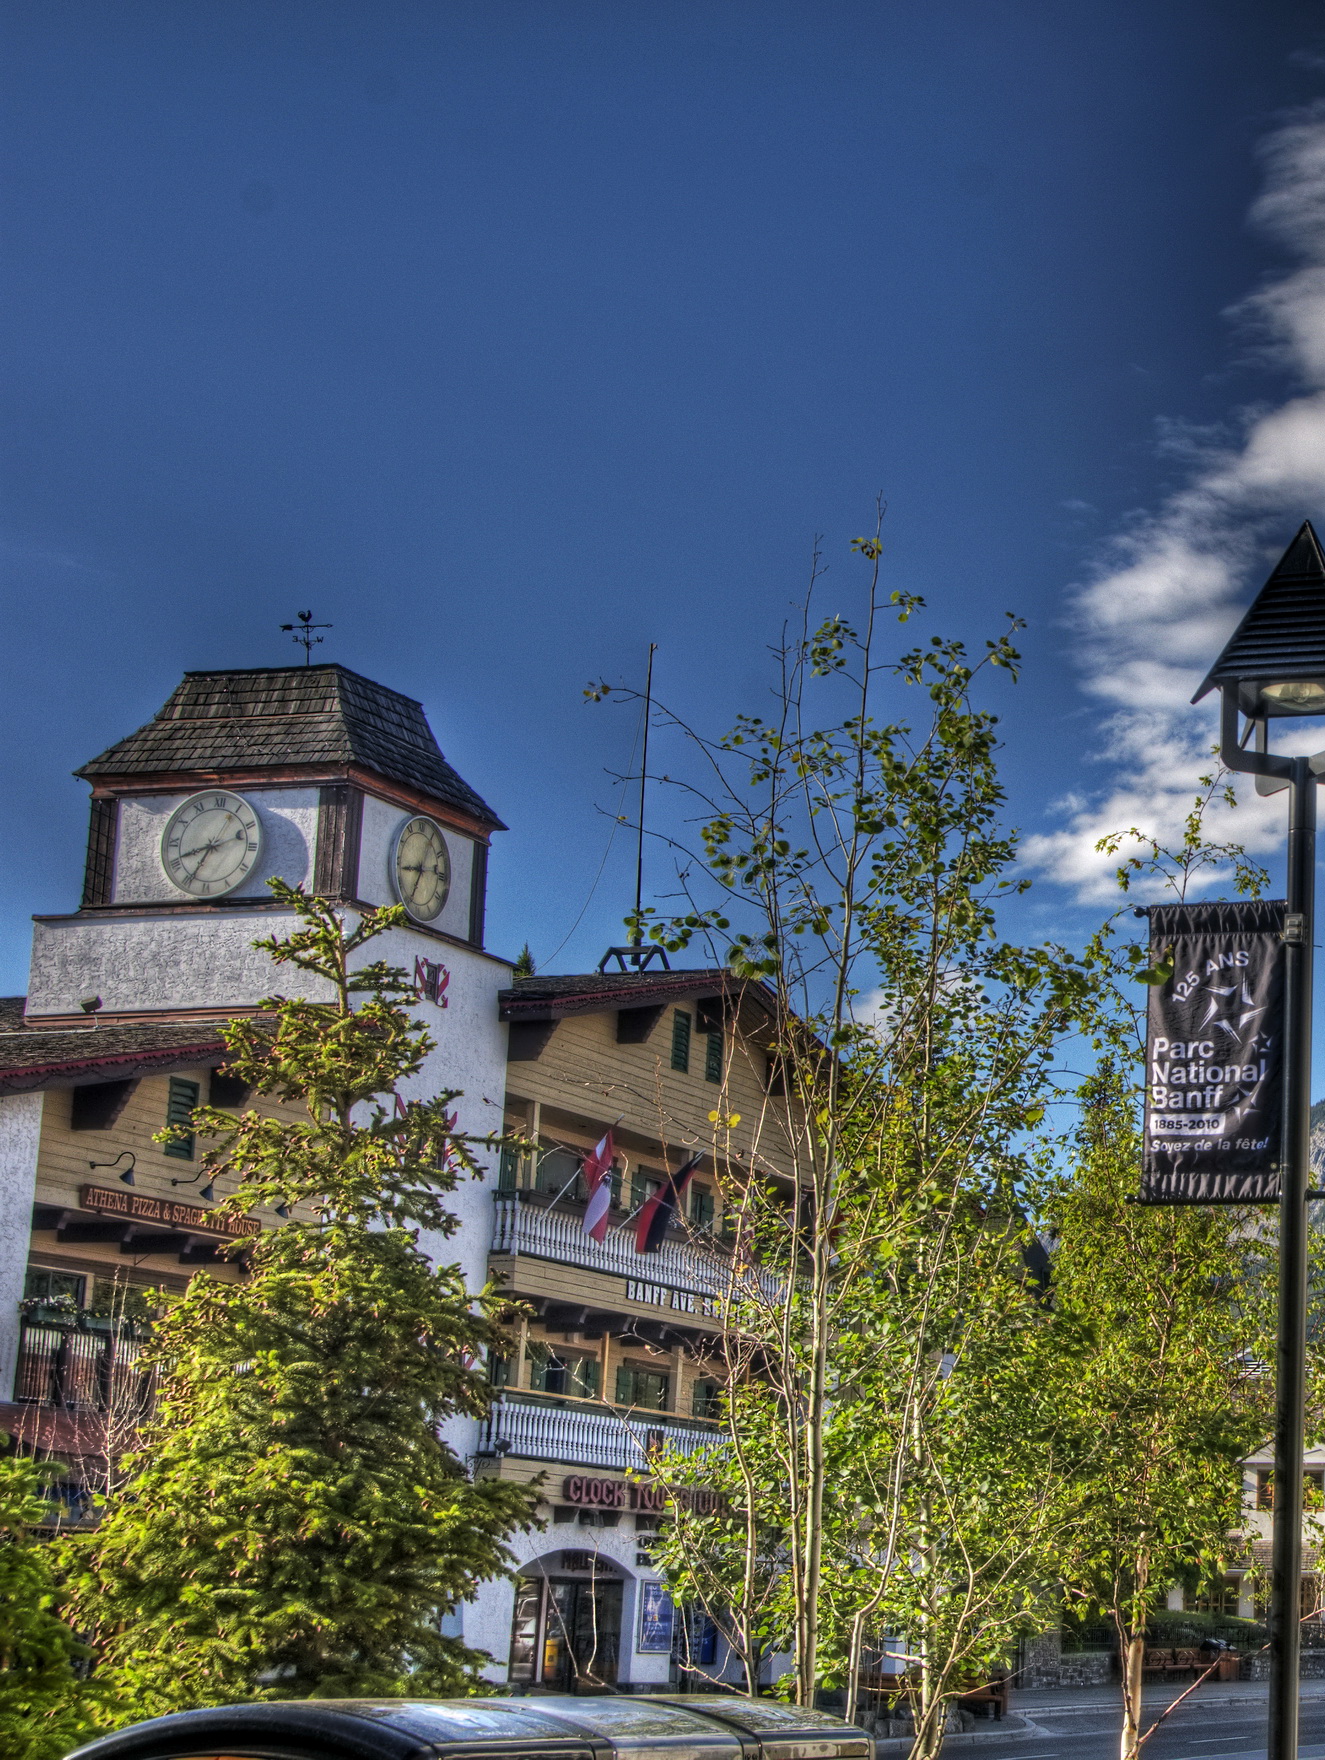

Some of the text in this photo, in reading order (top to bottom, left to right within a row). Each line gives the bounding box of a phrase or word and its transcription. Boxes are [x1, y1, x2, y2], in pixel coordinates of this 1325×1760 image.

[1172, 951, 1249, 1002] 125 ANS
[1152, 1037, 1215, 1060] Parc
[1151, 1059, 1266, 1085] National
[1150, 1084, 1224, 1109] Banff
[1154, 1119, 1220, 1130] 1885-2010
[1150, 1137, 1269, 1154] Soyez de la fête!
[86, 1188, 128, 1212] ATHENA
[131, 1197, 160, 1218] PIZZA
[163, 1203, 171, 1220] &
[228, 1219, 260, 1236] HOUSE
[627, 1279, 667, 1306] BANFF
[672, 1291, 698, 1314] AVE.
[568, 1475, 626, 1507] CLOCK
